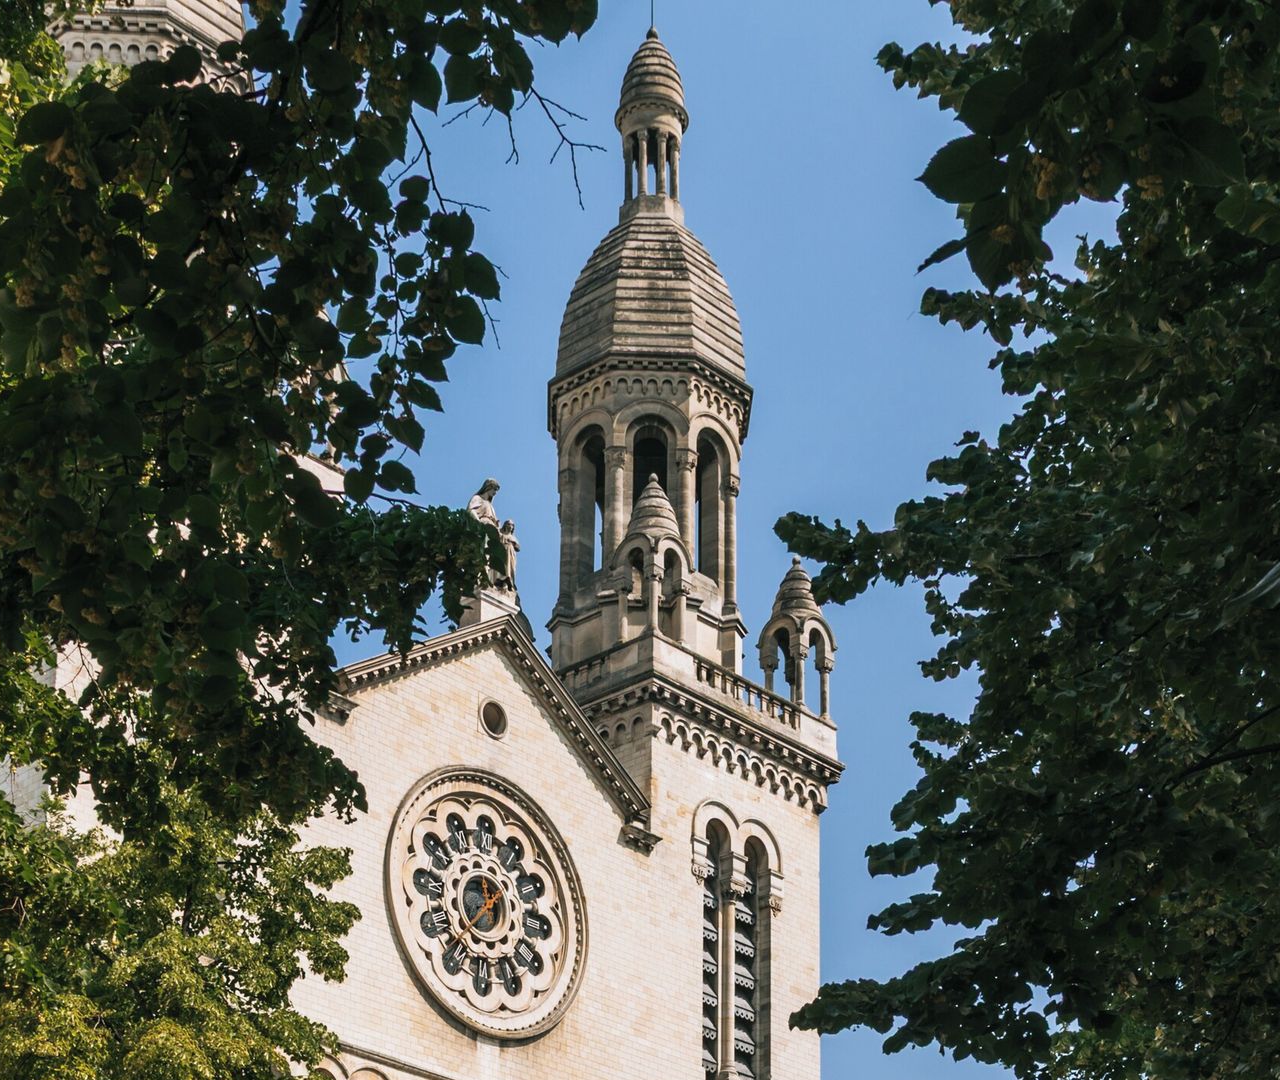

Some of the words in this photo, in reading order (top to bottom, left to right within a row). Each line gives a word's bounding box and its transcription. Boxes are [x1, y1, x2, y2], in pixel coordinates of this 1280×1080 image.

[481, 831, 492, 850] XII
[436, 847, 450, 864] X
[428, 877, 443, 894] IX
[521, 884, 534, 894] II
[432, 910, 449, 931] VIII
[526, 917, 540, 930] III
